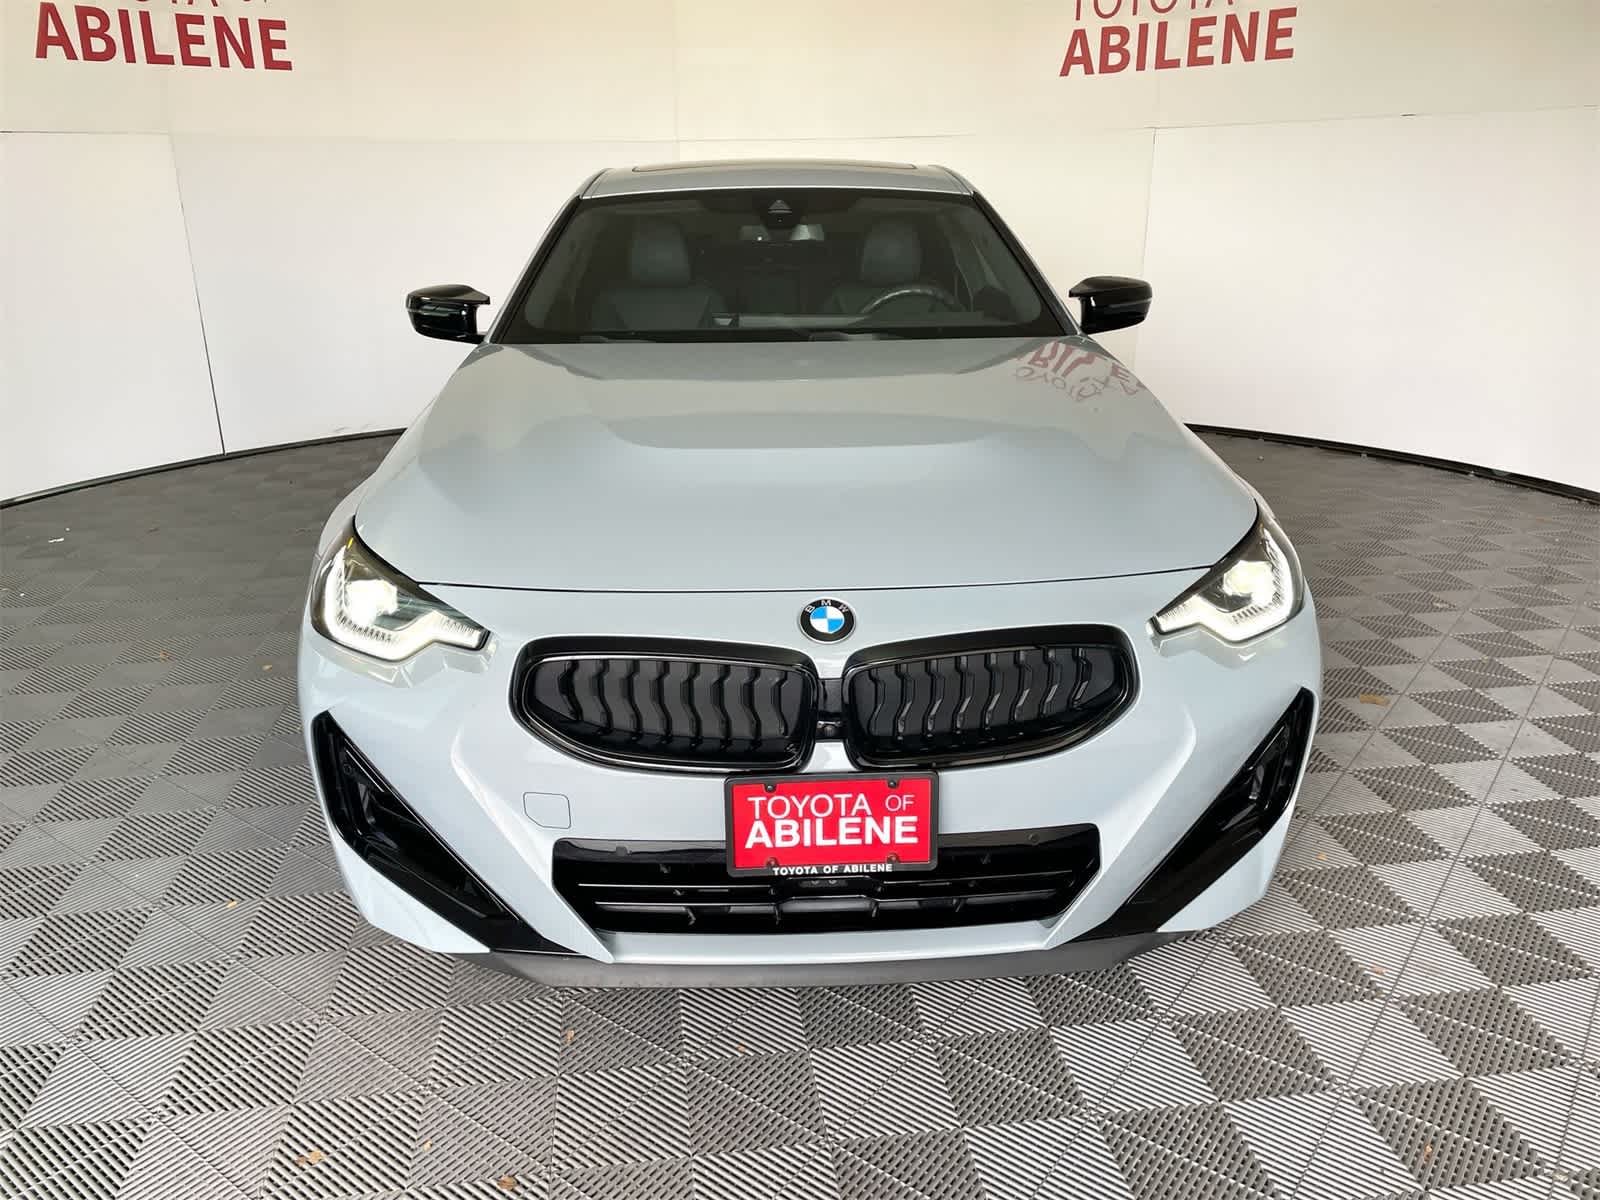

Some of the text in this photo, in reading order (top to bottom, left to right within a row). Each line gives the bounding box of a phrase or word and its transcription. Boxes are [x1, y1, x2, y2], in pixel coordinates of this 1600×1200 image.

[35, 1, 293, 71] ABILENE
[1059, 7, 1297, 77] ABILENE
[805, 599, 849, 613] BMW
[747, 793, 915, 820] TOYOTA OF
[745, 816, 919, 849] ABILENE
[772, 863, 893, 876] TOYOTA OF ABILENE
